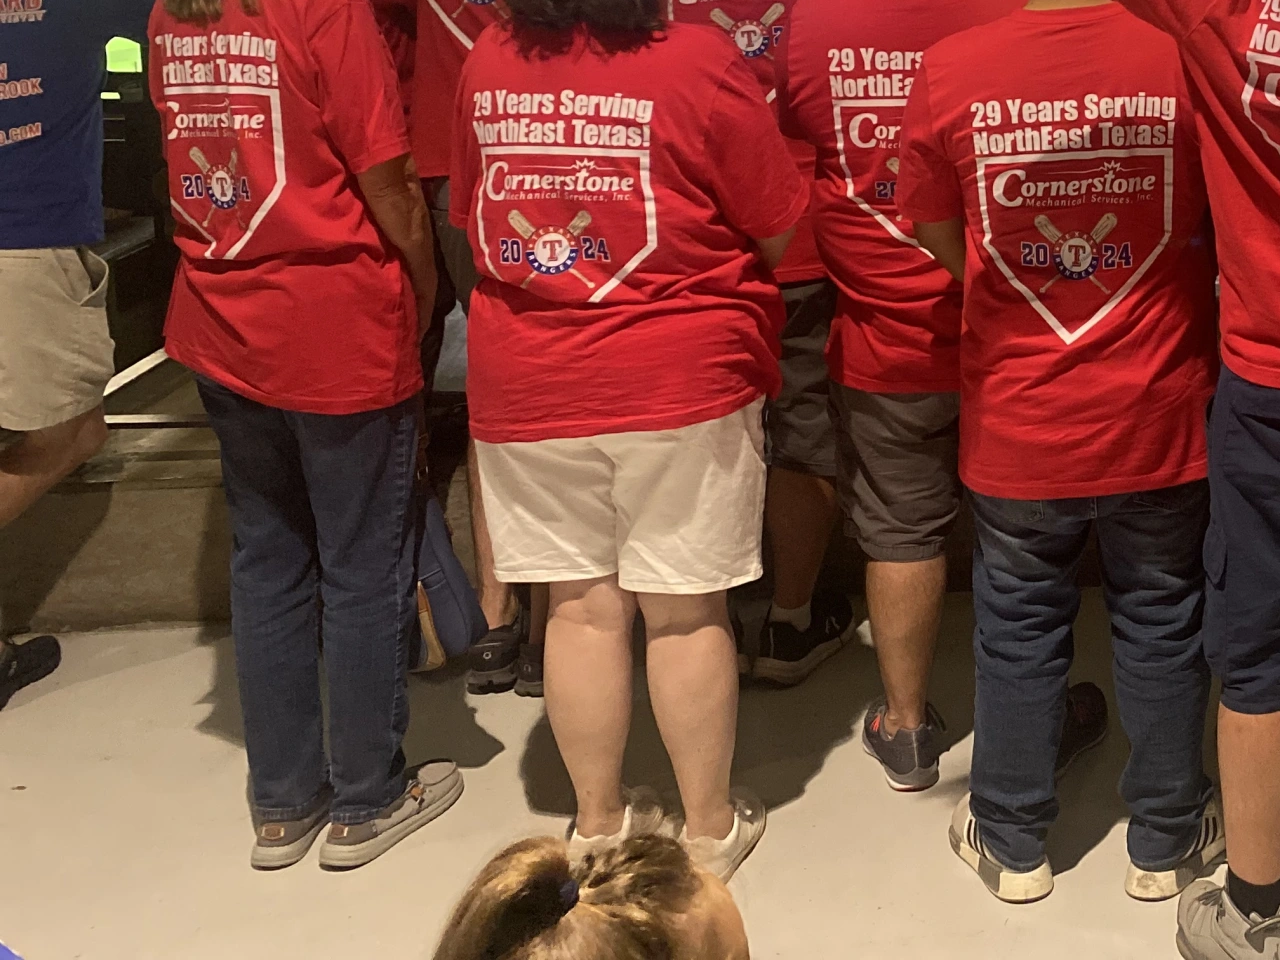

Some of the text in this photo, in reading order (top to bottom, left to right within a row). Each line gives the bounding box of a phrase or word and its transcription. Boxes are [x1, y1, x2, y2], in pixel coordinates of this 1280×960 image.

[828, 48, 855, 72] 29
[473, 89, 654, 123] 29 Years Serving
[970, 92, 1176, 127] 29 Years Serving
[473, 118, 651, 147] NorthEast Texas!
[972, 122, 1175, 155] NorthEast Texas!
[181, 174, 204, 199] 20
[486, 161, 634, 201] Cornerstone
[993, 169, 1156, 207] Cornerstone
[1026, 197, 1086, 207] Mechanical
[500, 237, 611, 264] 20 24
[527, 251, 576, 273] RANGERS
[1021, 242, 1132, 269] 20 24
[1055, 257, 1098, 279] RANGERS
